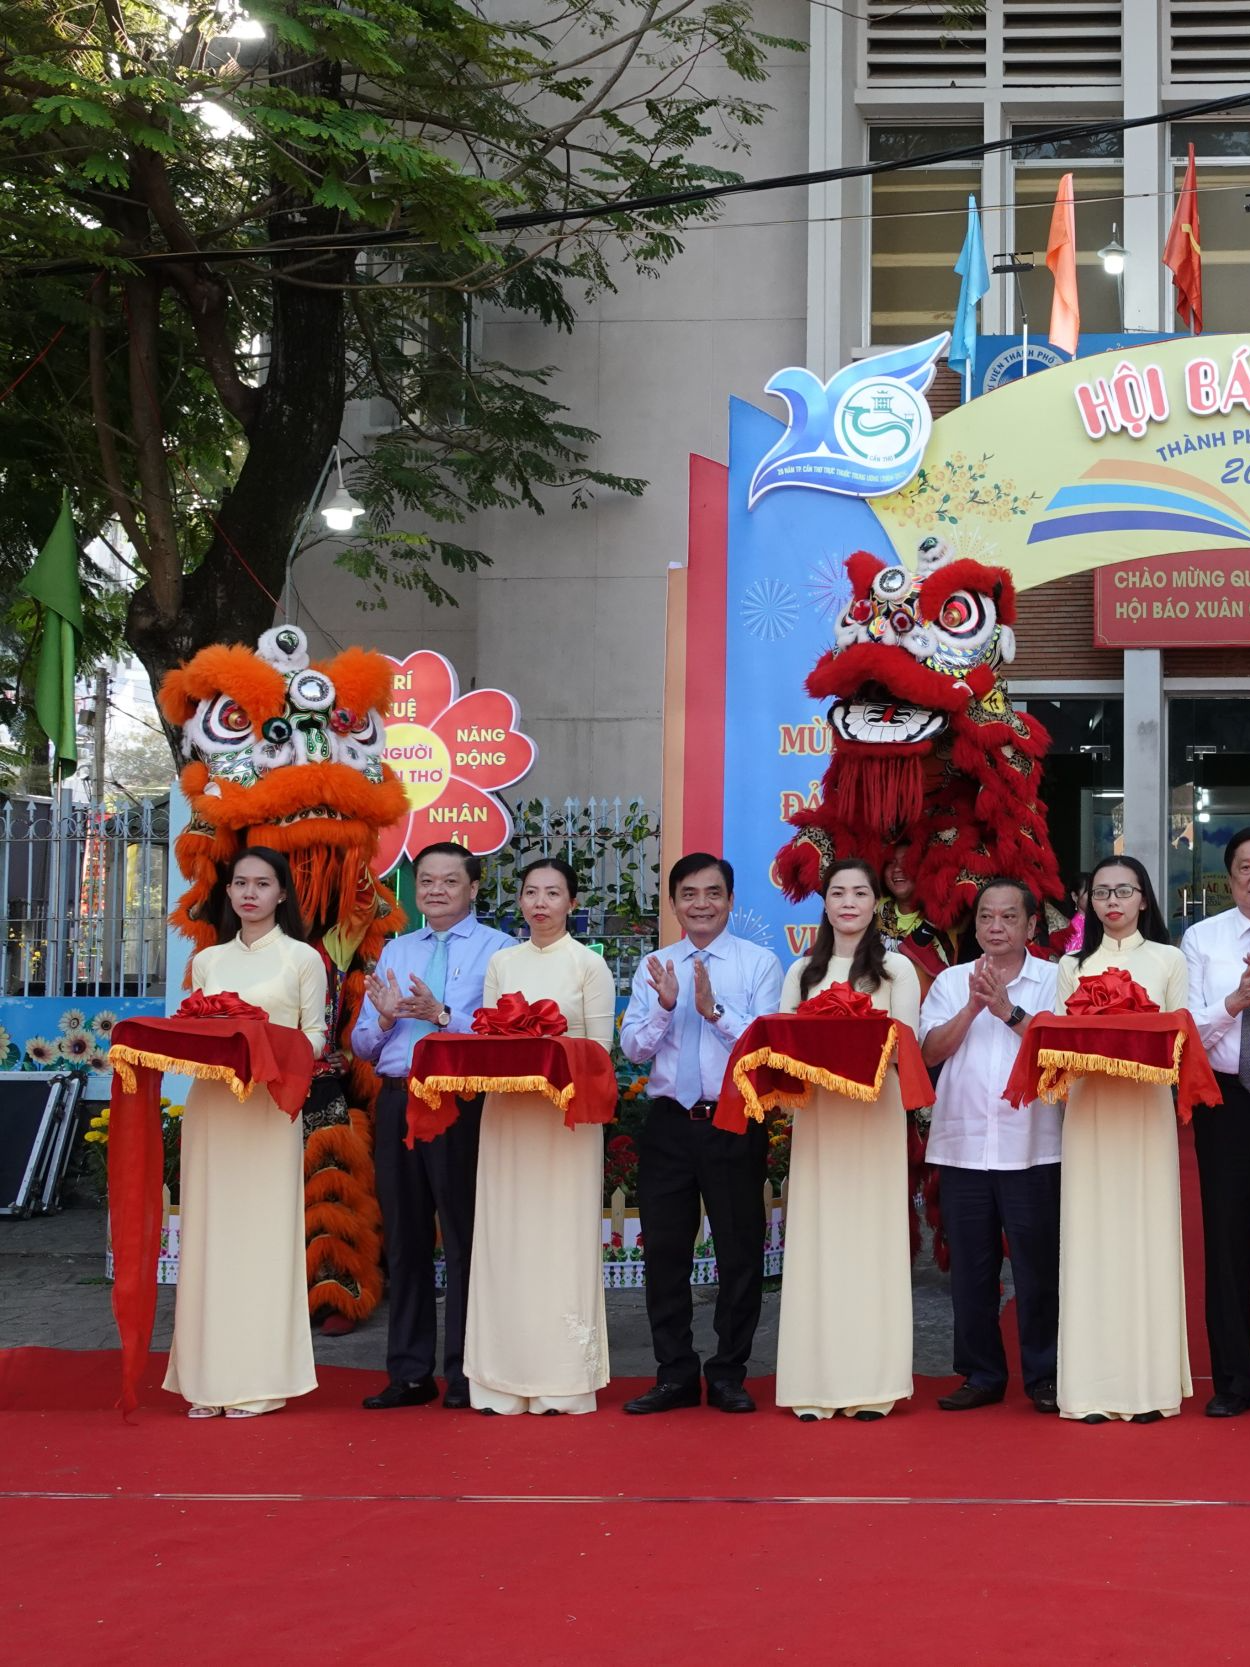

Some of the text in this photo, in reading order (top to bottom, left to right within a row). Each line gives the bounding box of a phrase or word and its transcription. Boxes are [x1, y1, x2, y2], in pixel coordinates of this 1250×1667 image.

[1077, 363, 1168, 436] HỘI
[1156, 431, 1226, 462] THÀNH
[1114, 567, 1167, 588] CHÀO
[1172, 566, 1225, 587] MỪNG
[1115, 597, 1148, 623] HỘI
[1153, 597, 1190, 618] BÁO
[1195, 597, 1243, 618] XUÂN
[393, 670, 413, 690] RÍ
[385, 698, 417, 722] UỆ
[456, 726, 506, 742] NĂNG
[456, 749, 507, 769] ĐỘNG
[409, 768, 443, 783] THƠ
[428, 803, 488, 823] NHÂN
